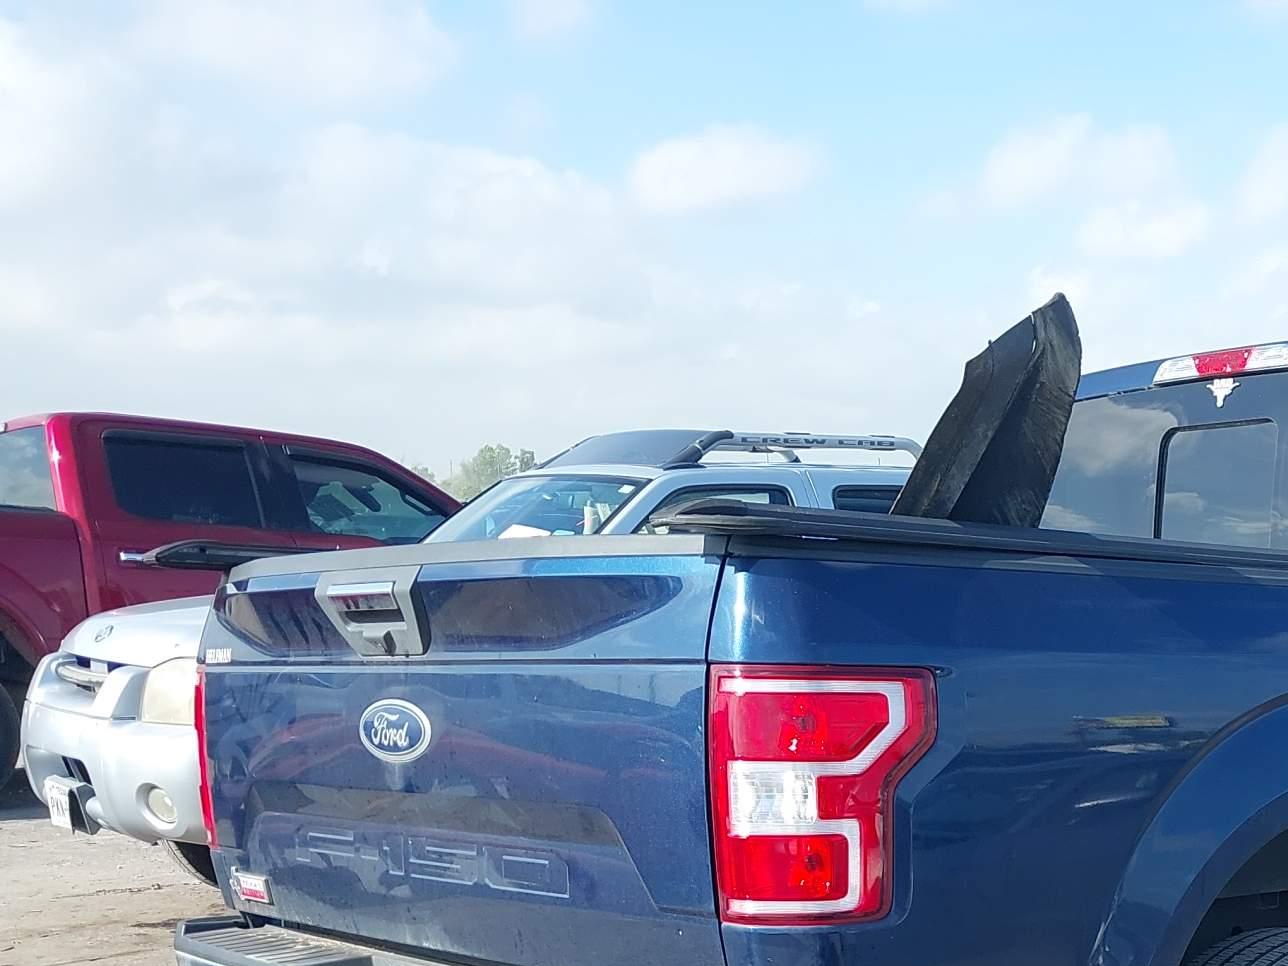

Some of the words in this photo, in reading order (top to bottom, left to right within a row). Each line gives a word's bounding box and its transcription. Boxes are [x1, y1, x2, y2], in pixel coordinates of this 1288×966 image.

[740, 436, 827, 445] CREW
[838, 439, 895, 447] CAB
[371, 711, 410, 747] Ford
[296, 830, 569, 898] F-150
